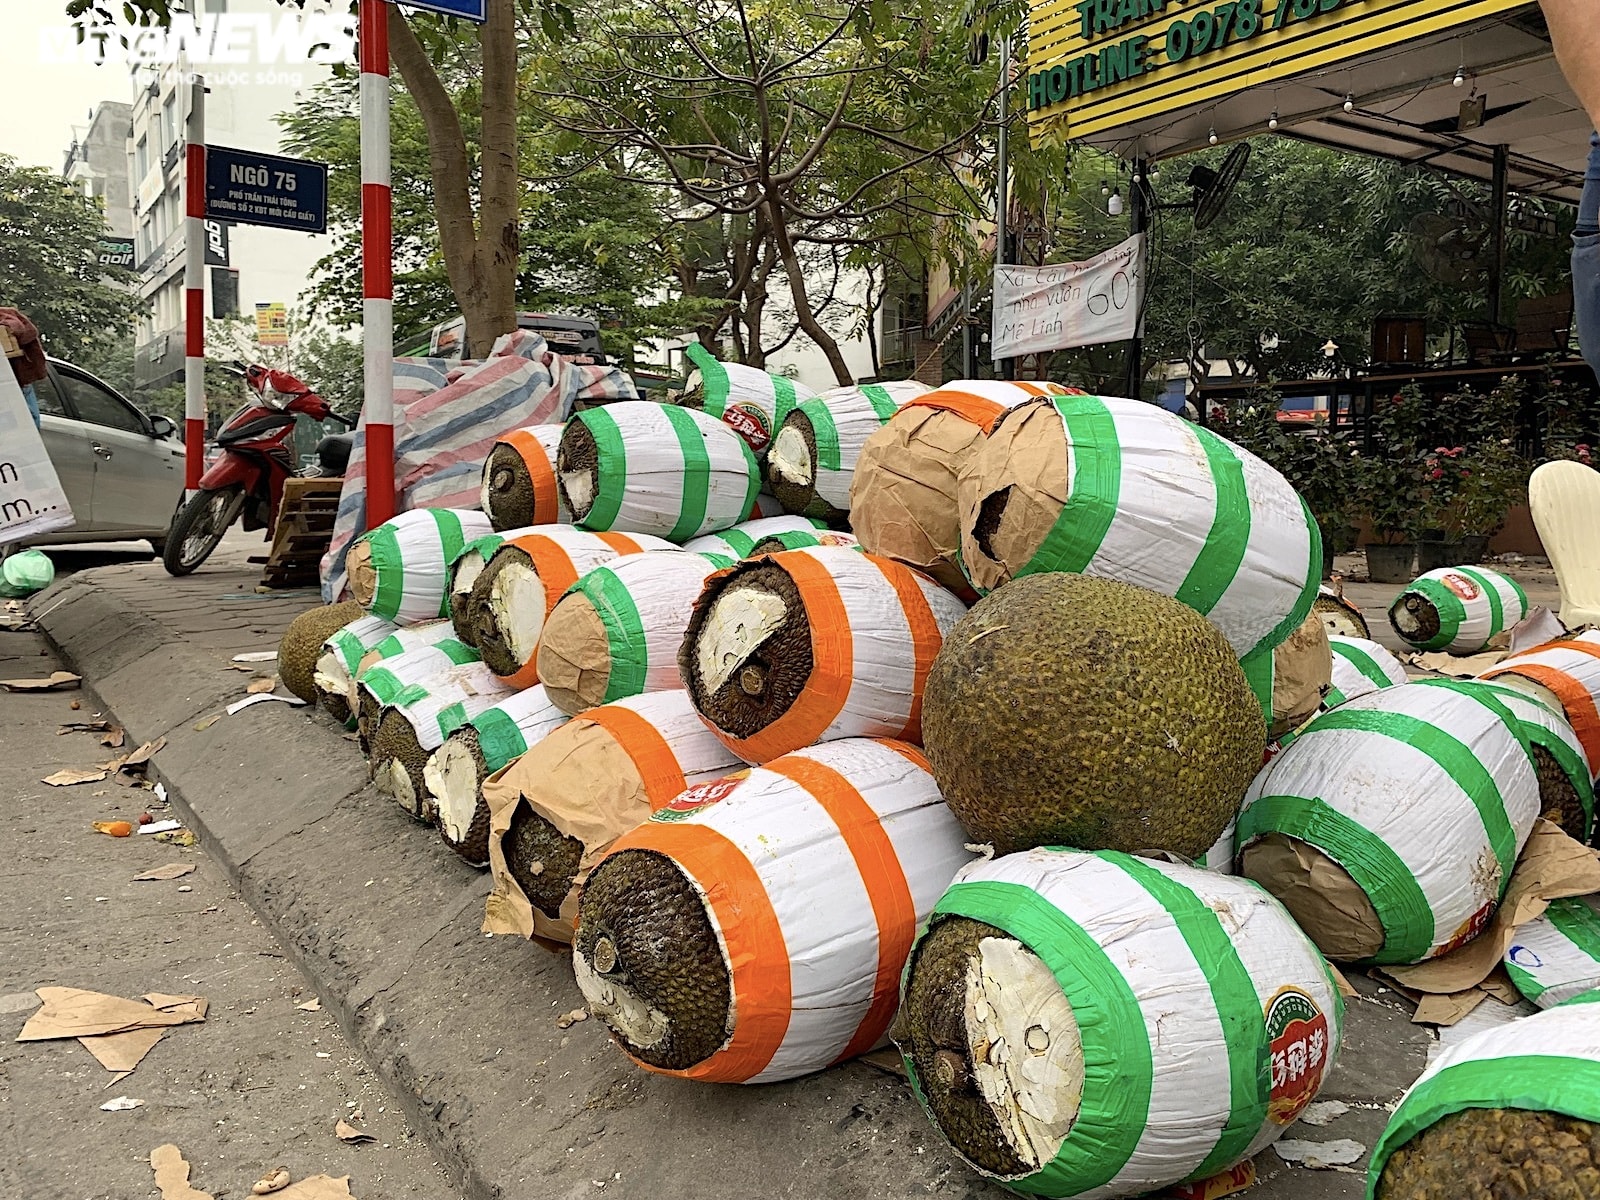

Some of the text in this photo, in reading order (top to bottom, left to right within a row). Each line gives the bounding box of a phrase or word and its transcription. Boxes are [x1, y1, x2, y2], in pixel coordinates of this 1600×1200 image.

[1030, 35, 1156, 109] HOTLINE:
[1166, 0, 1258, 62] 0978
[230, 164, 297, 192] NGÕ 75
[228, 189, 243, 200] PHỐ
[237, 201, 249, 212] SỐ
[248, 204, 254, 213] 2
[99, 253, 134, 266] golf
[1031, 312, 1063, 336] Linh
